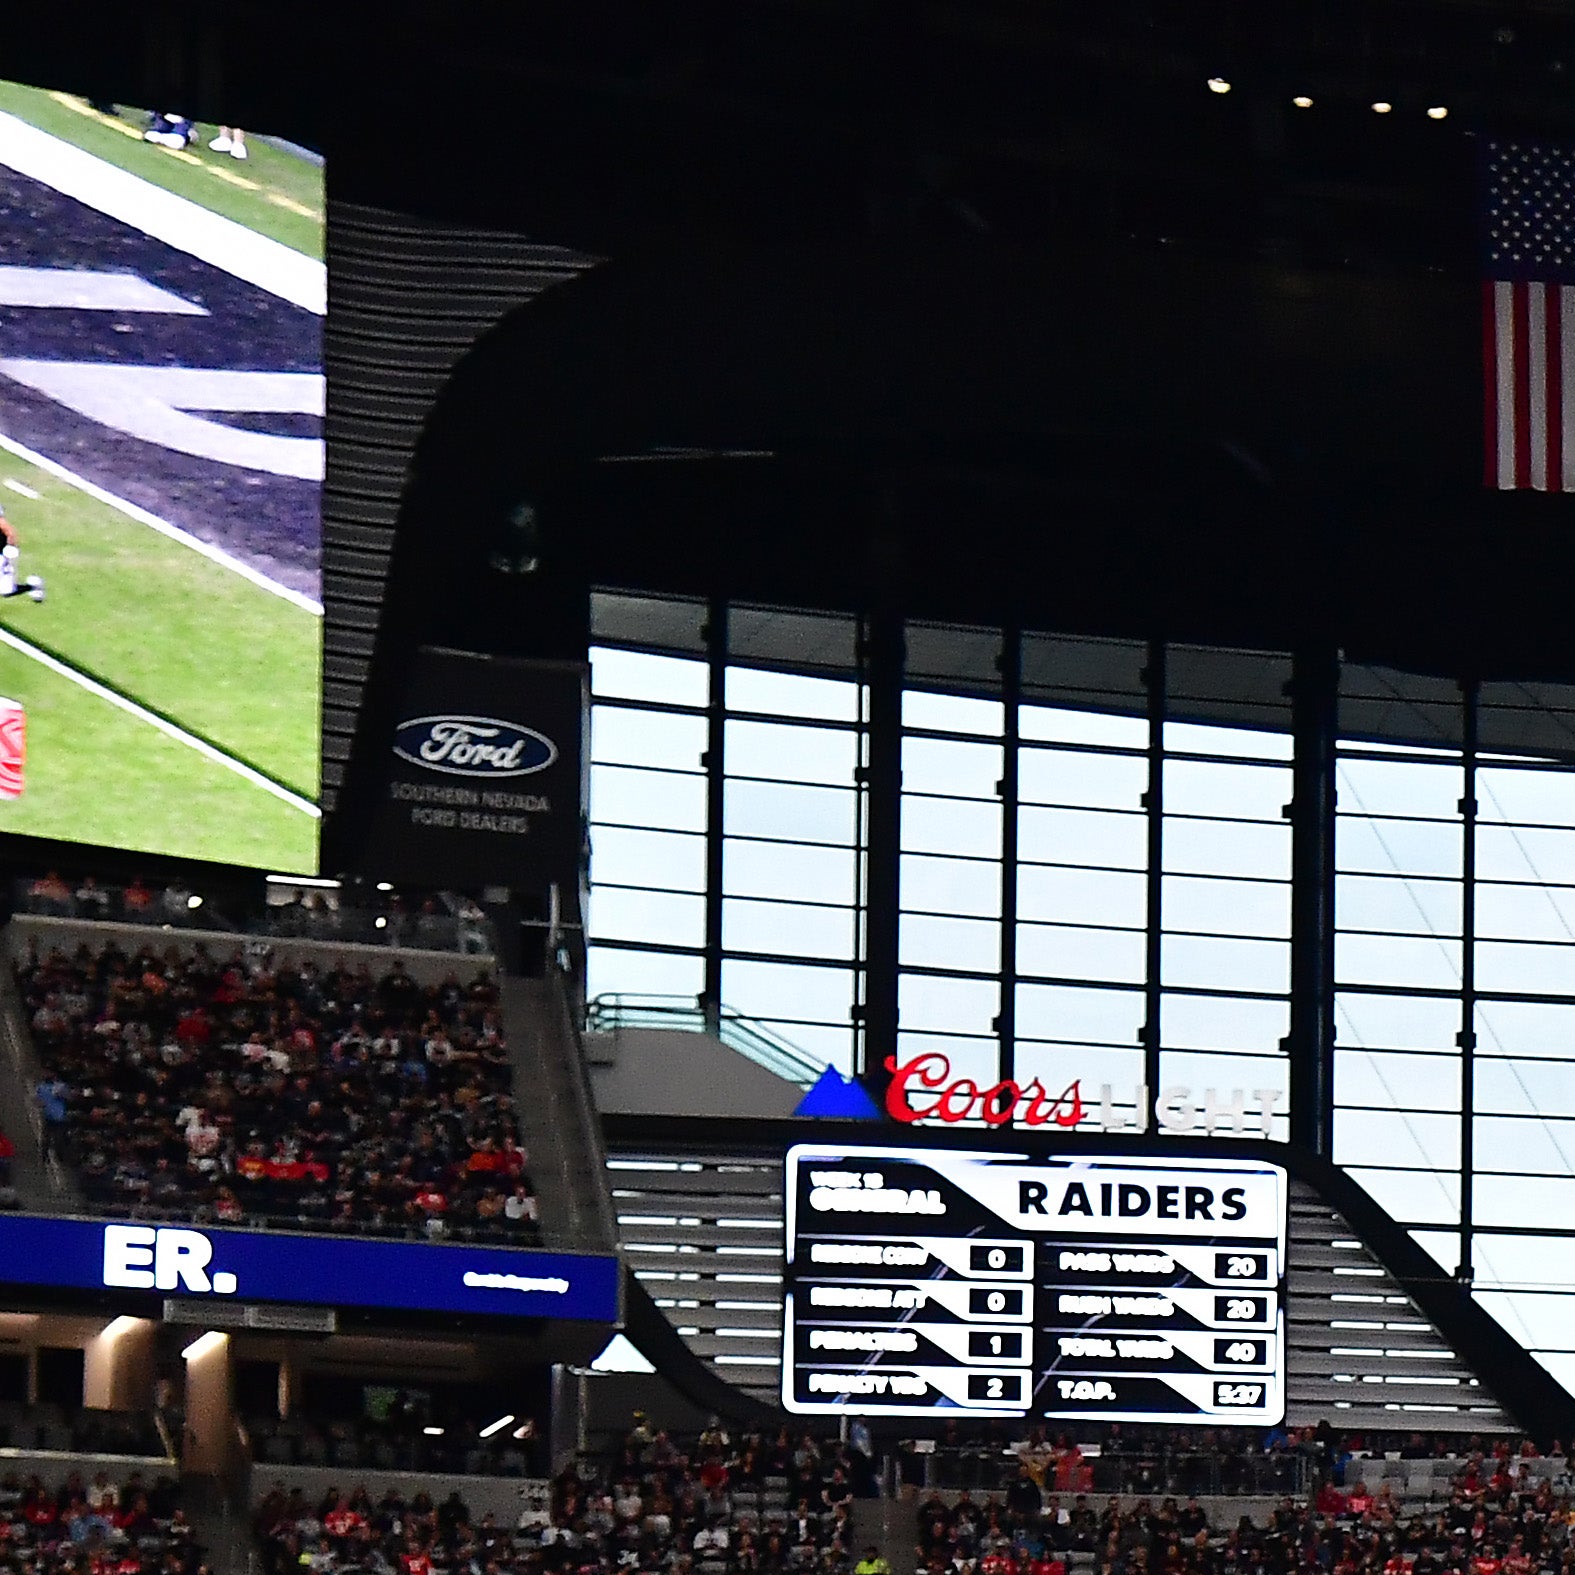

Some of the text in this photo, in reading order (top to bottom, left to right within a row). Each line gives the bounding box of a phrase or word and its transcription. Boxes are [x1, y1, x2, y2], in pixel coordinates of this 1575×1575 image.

[420, 722, 525, 768] Ford
[482, 792, 550, 812] NEVADA
[411, 807, 528, 834] FORD DEALERS
[884, 1052, 1284, 1136] Coors LIGHT
[1019, 1180, 1247, 1221] RAIDERS
[103, 1224, 237, 1294] ER.
[988, 1249, 1006, 1269] 0
[1227, 1257, 1256, 1276] 20
[987, 1292, 1005, 1311] 0
[1227, 1300, 1255, 1319] 20
[990, 1335, 1001, 1354] 1
[1225, 1342, 1256, 1362] 40
[987, 1378, 1003, 1397] 2
